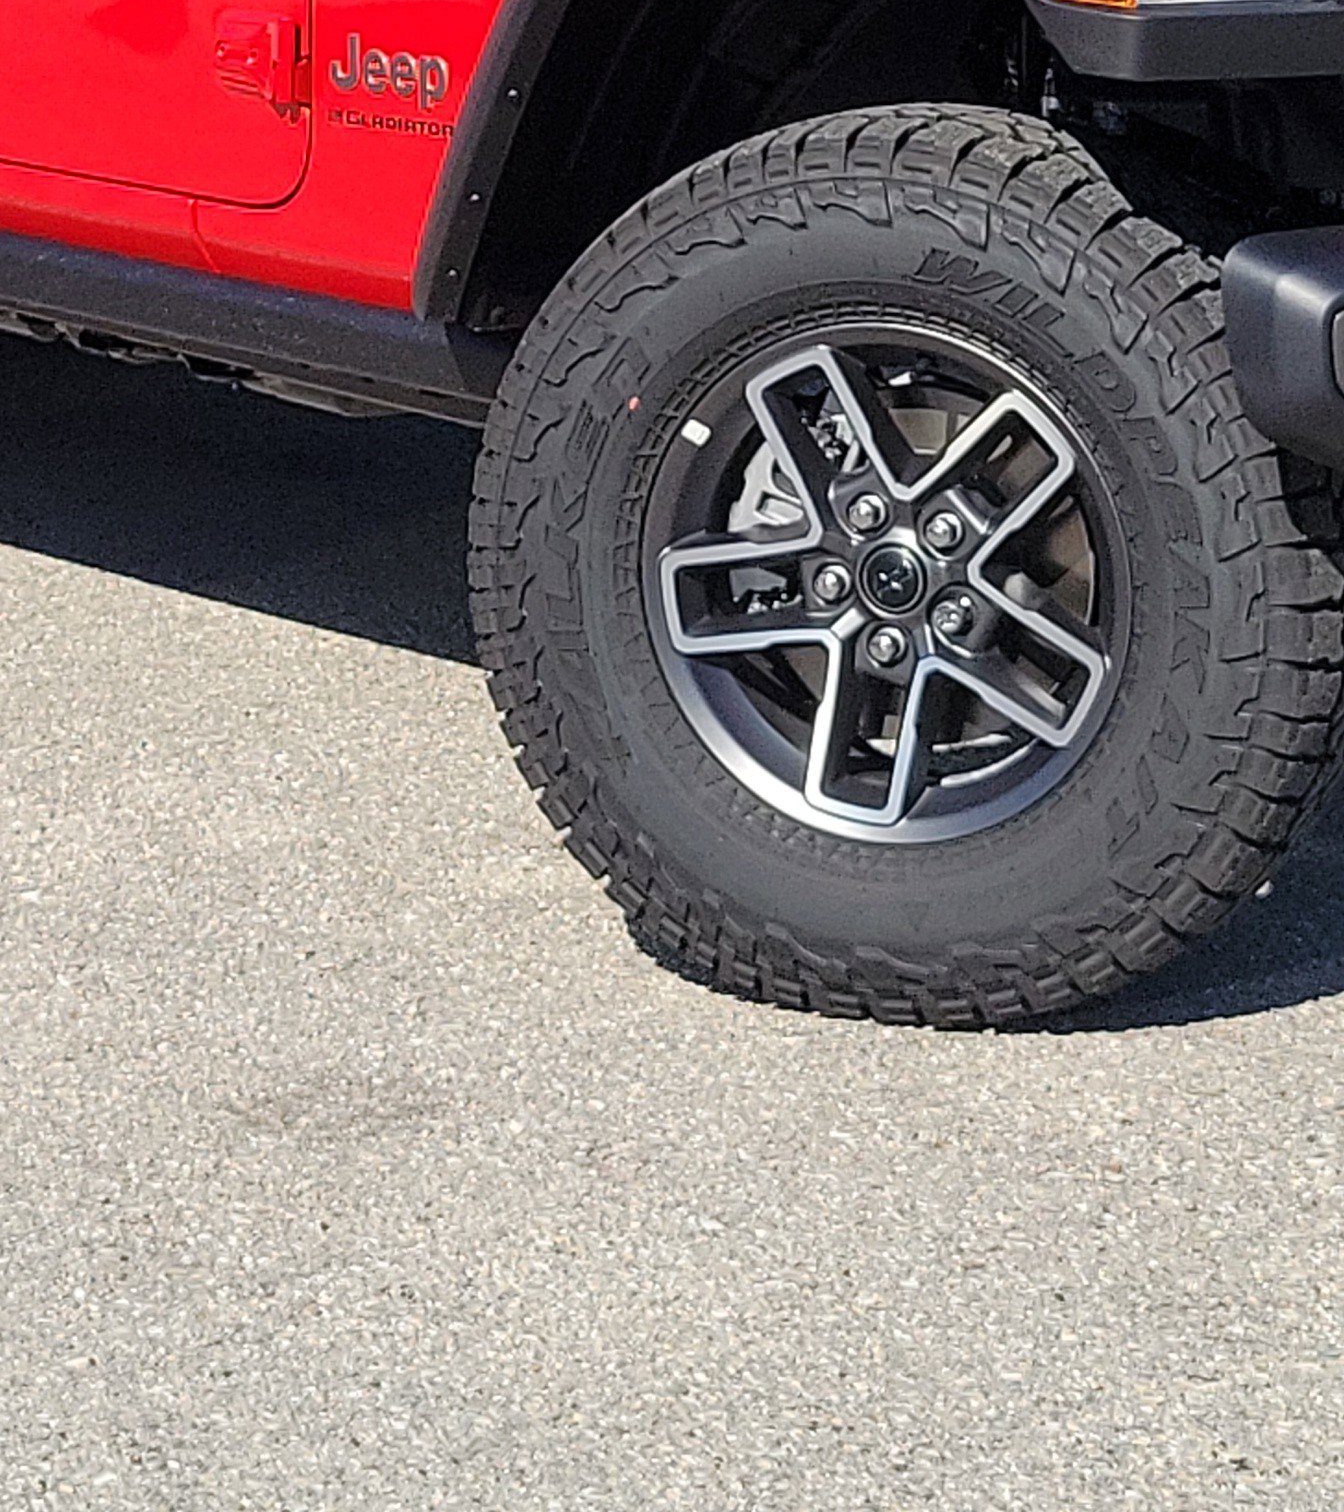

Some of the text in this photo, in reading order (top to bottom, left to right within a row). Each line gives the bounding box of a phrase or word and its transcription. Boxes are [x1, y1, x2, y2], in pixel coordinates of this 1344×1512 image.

[329, 32, 449, 110] Jeep
[346, 109, 454, 136] GLADIATOR
[906, 247, 1212, 694] WILDPEAK
